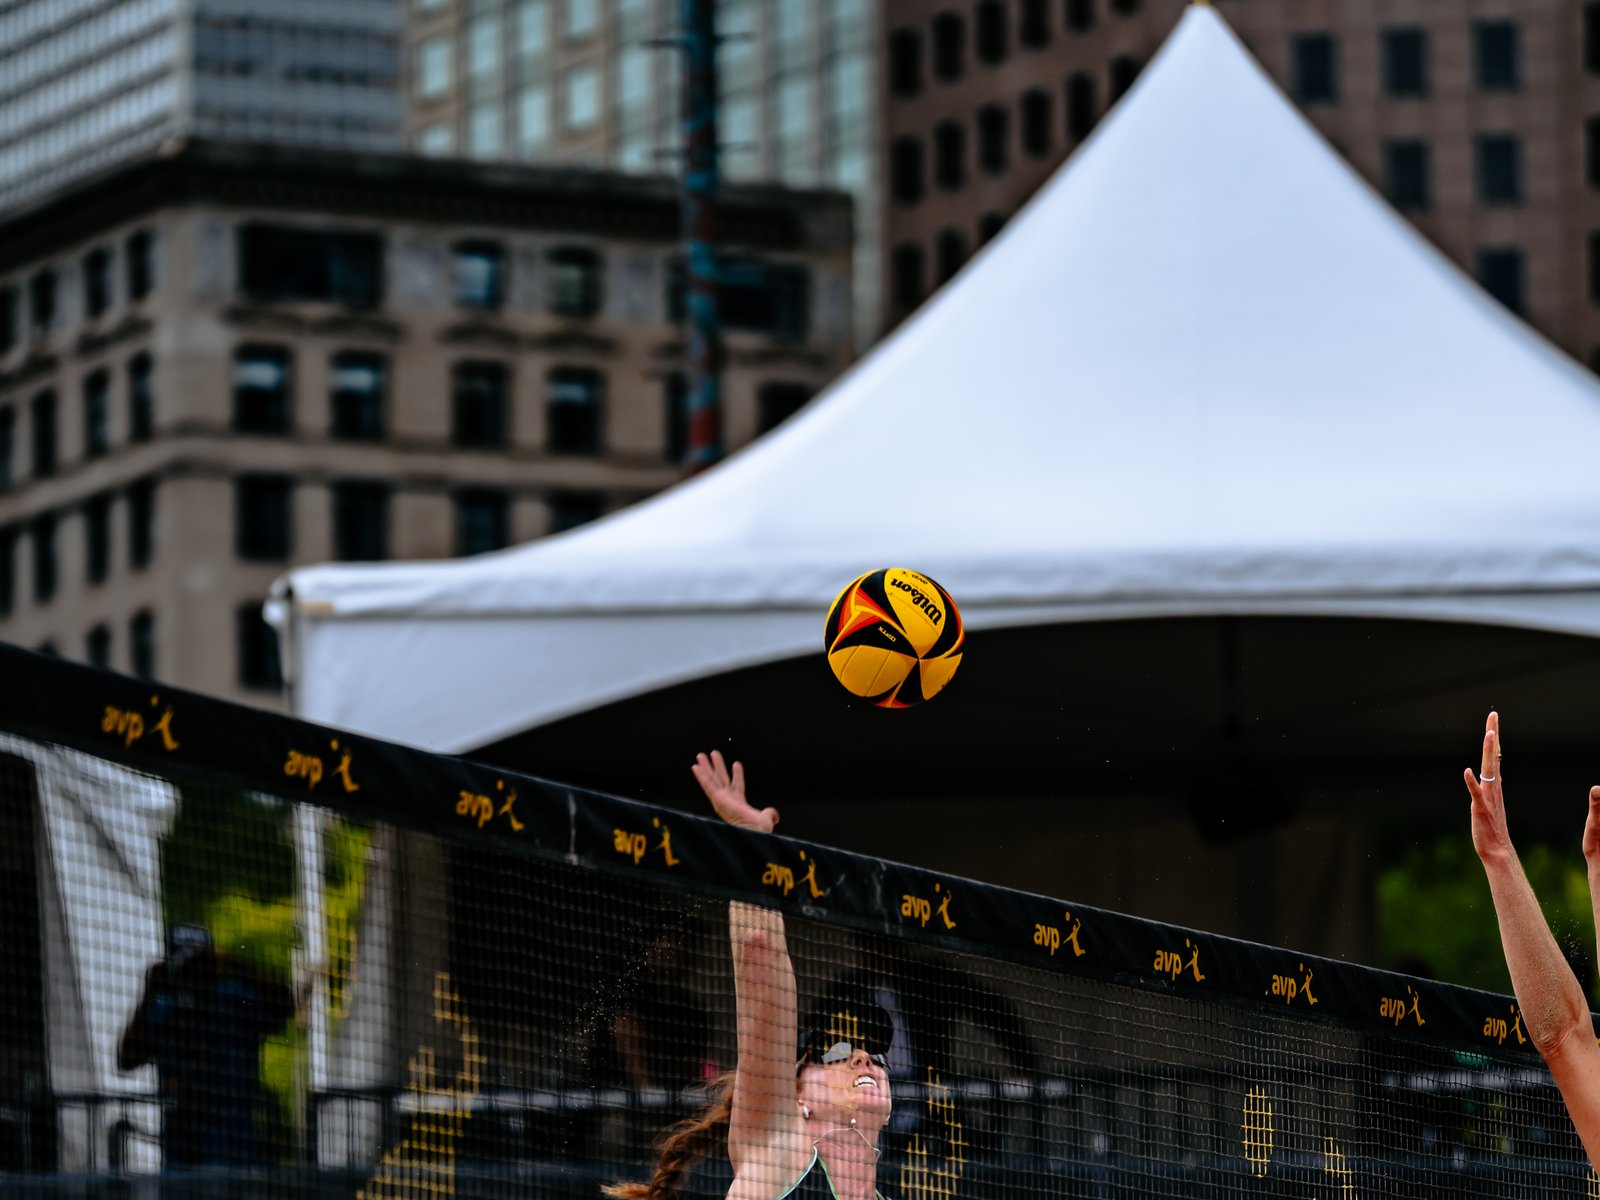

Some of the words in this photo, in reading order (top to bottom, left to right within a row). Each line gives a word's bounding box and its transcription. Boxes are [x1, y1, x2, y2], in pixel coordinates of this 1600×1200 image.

[890, 578, 942, 626] Wilson
[104, 707, 143, 742] avp
[285, 751, 322, 785] avp
[456, 791, 493, 827] avp
[613, 829, 646, 864] avp
[762, 863, 794, 896] avp
[901, 894, 931, 927] avp
[1033, 923, 1060, 956] avp
[1153, 949, 1182, 980] avp
[1271, 974, 1297, 1005] avp
[1379, 997, 1406, 1025] avp
[1483, 1017, 1507, 1044] avp
